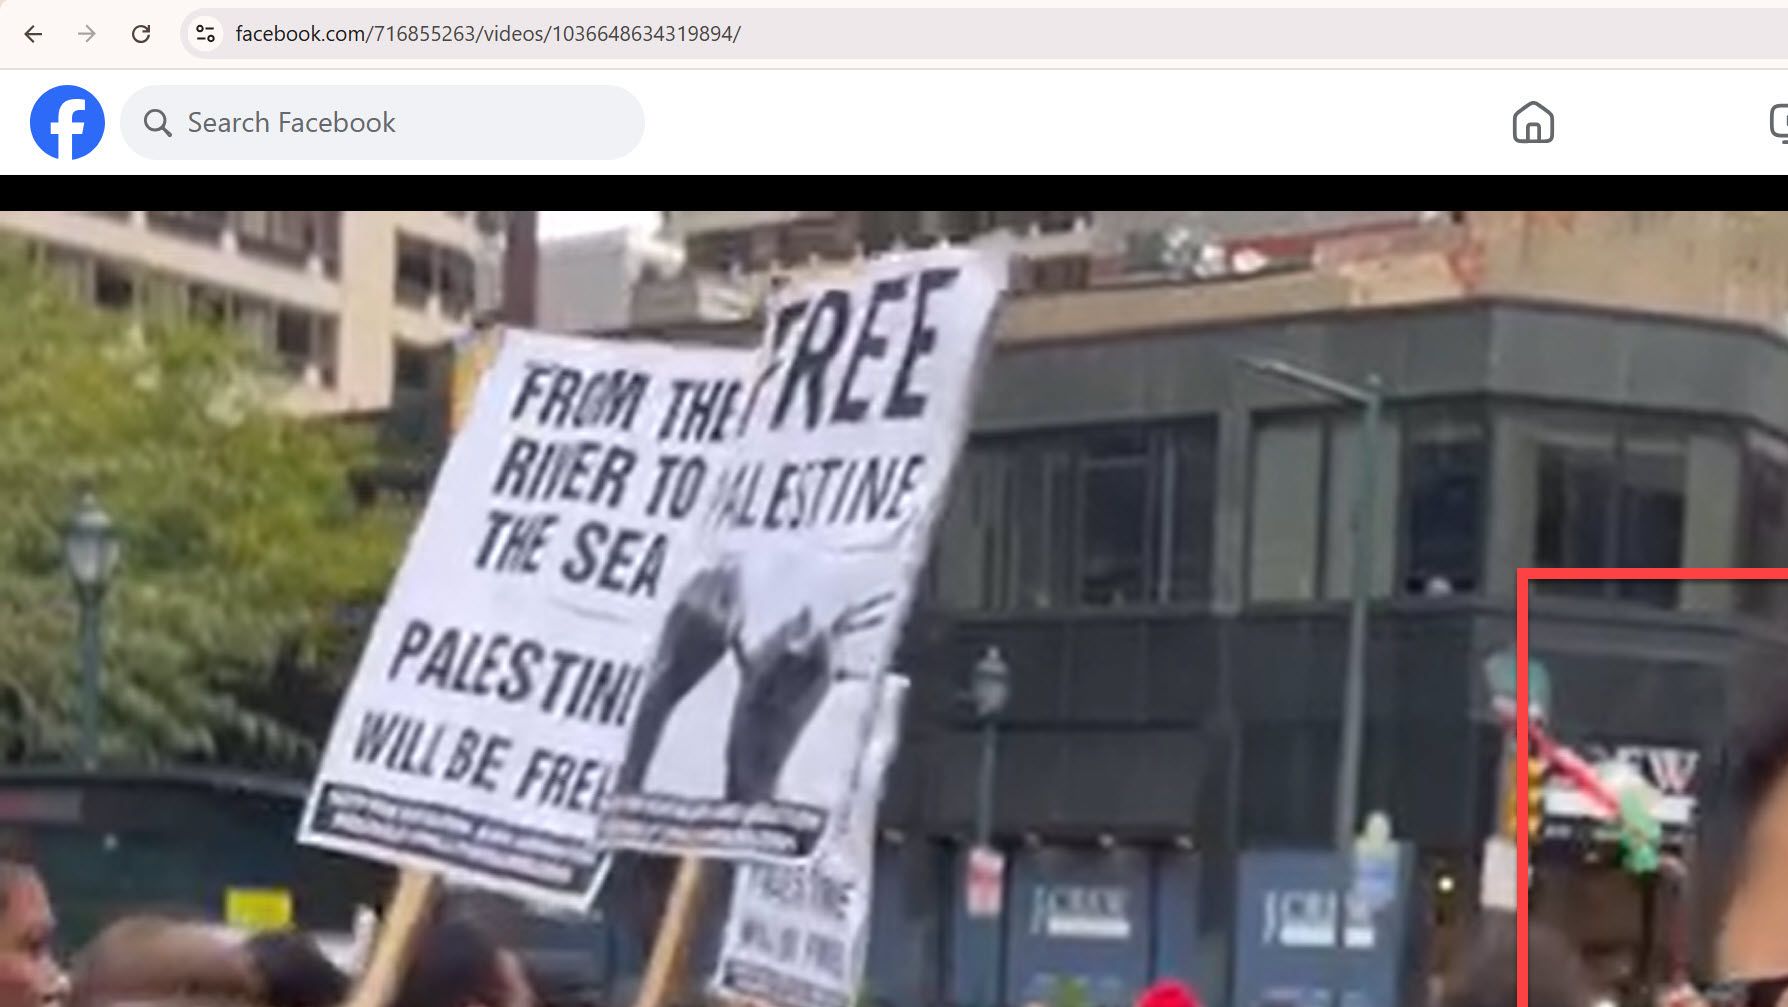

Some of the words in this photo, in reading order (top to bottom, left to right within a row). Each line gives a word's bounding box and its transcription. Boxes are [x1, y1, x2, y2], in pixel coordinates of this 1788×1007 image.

[235, 24, 742, 44] facebook.com/716855263/videos/1036648634319894/
[188, 110, 270, 133] Search
[279, 110, 397, 133] Facebook
[511, 361, 651, 432] FROM
[656, 378, 742, 442] THE
[644, 454, 708, 519] TO
[474, 508, 560, 575] THE
[560, 520, 669, 598] SEA
[352, 710, 446, 780] WILL
[443, 728, 514, 792] BE
